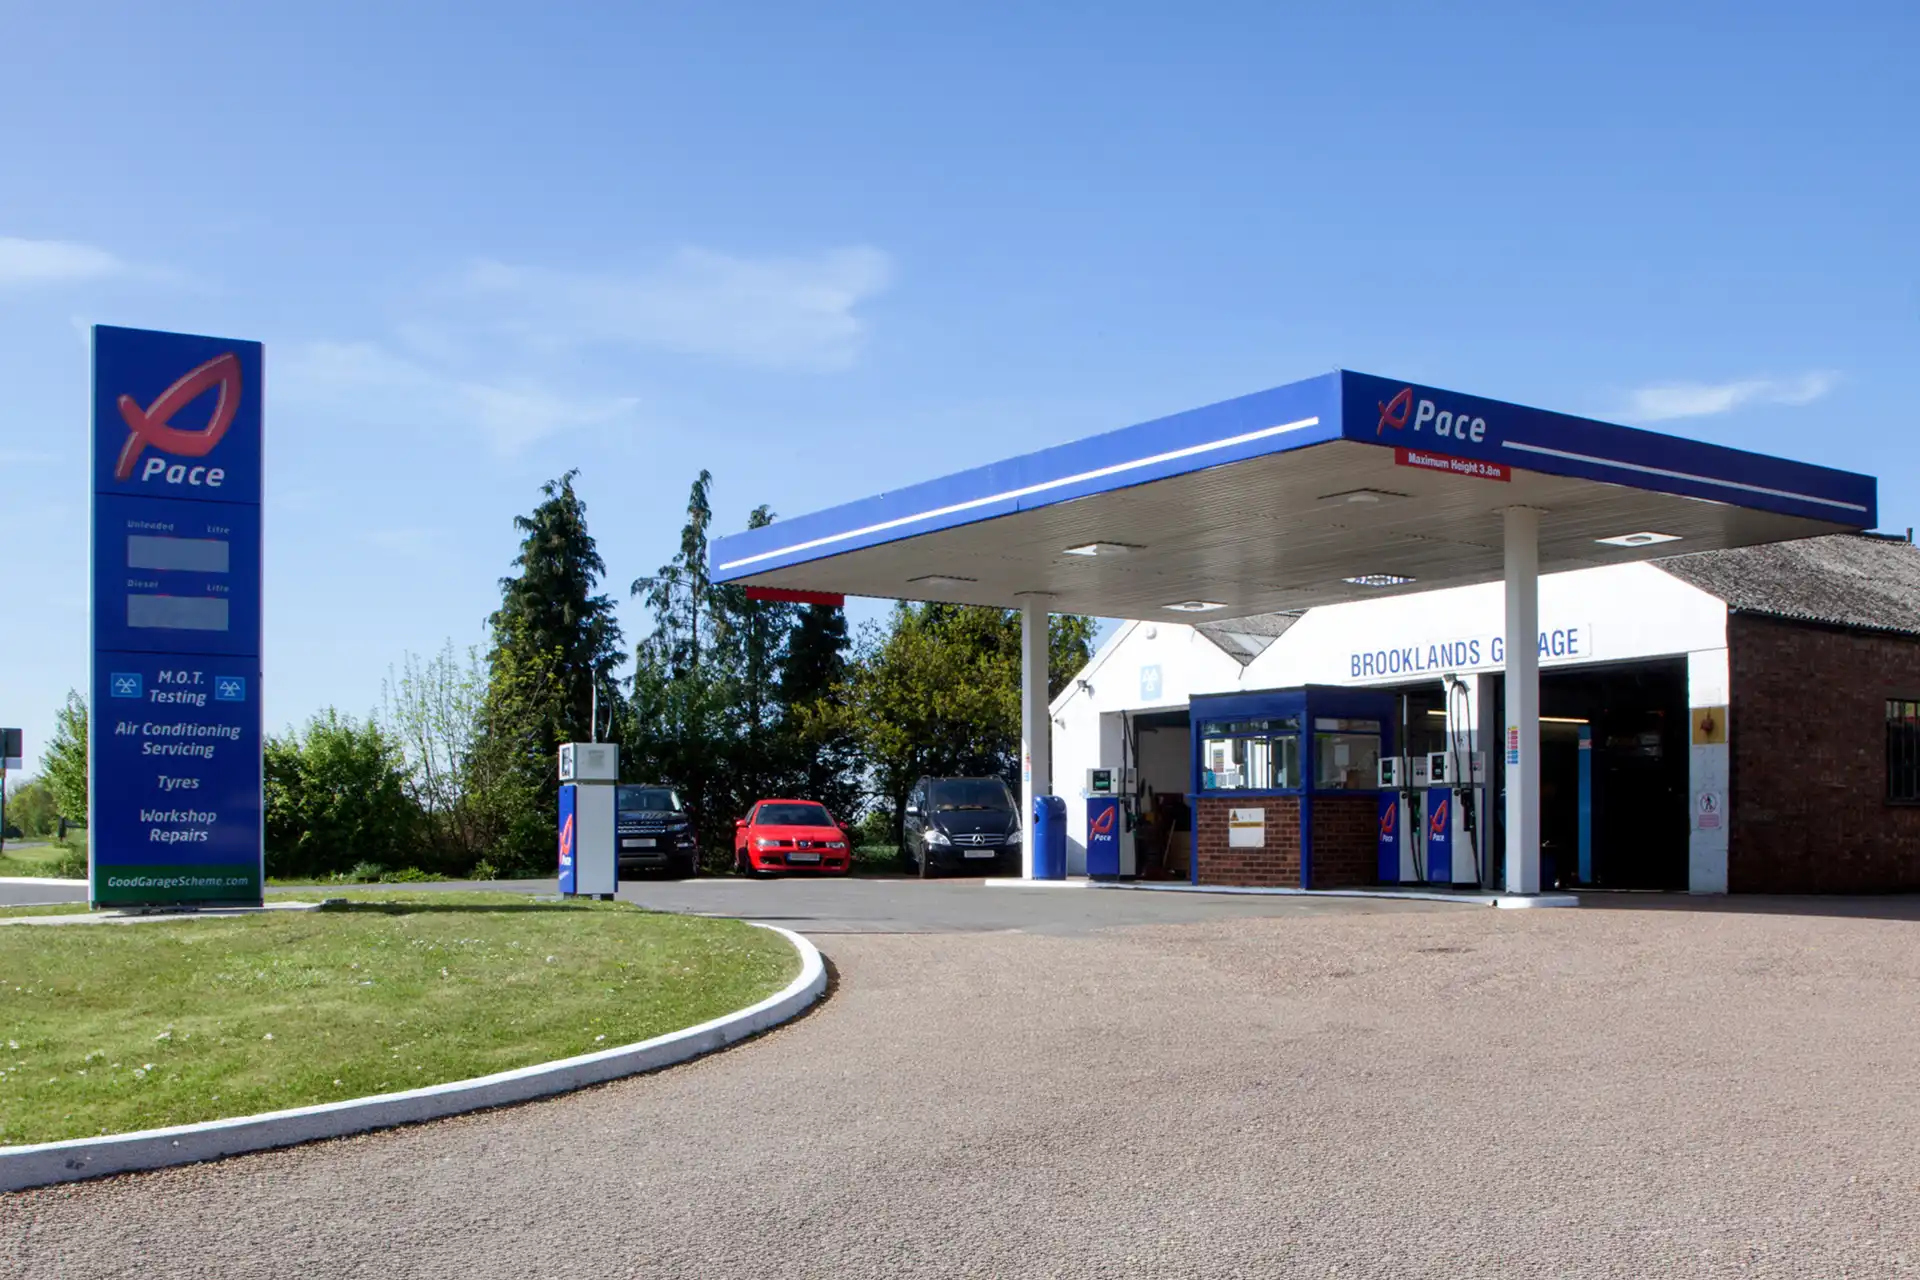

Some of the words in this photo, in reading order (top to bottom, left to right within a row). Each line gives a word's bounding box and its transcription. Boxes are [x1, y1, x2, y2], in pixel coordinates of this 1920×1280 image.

[1414, 399, 1486, 443] Pace
[142, 457, 225, 487] Pace
[1408, 452, 1449, 469] Maximum
[1451, 460, 1478, 474] Height
[1479, 464, 1501, 477] 3.8m
[127, 519, 174, 531] Unleaded
[206, 524, 230, 534] Litre
[127, 579, 159, 589] Diesel
[206, 584, 230, 592] Litre
[1351, 639, 1481, 677] BROOKLANDS
[1491, 630, 1579, 663] GAGE
[158, 670, 205, 685] M.O.T.
[149, 689, 207, 707] Testing
[115, 721, 139, 735] Air
[142, 722, 241, 740] Conditioning
[141, 741, 215, 759] Servicing
[158, 775, 200, 792] Tyres
[140, 808, 217, 825] Workshop
[149, 828, 208, 845] Repairs
[107, 876, 249, 888] GoodGarageScheme.com
